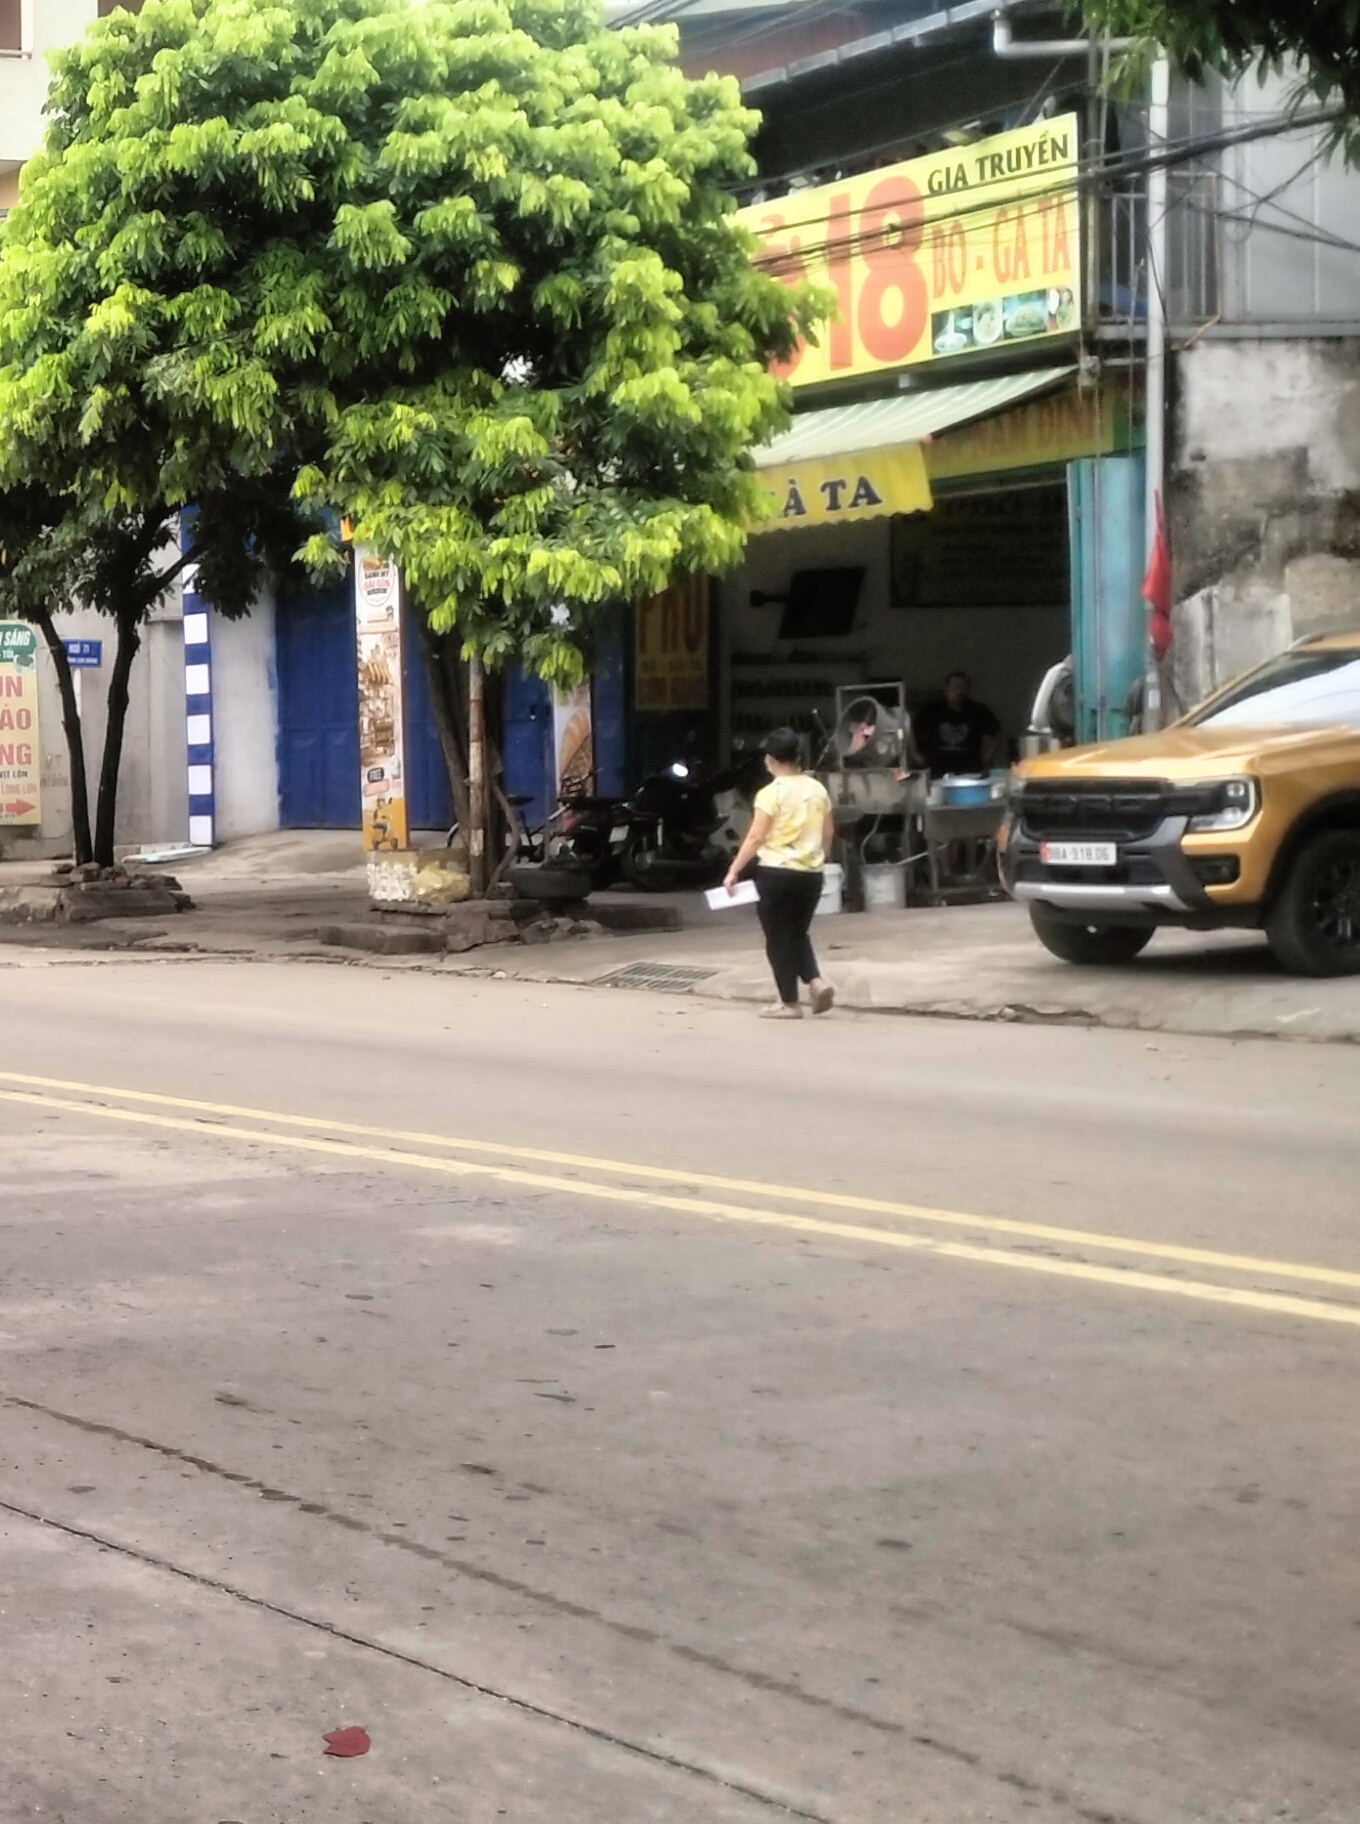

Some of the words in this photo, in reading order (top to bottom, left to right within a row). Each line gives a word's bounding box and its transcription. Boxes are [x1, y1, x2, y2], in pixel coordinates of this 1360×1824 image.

[927, 163, 968, 196] GIA
[975, 130, 1069, 182] TRUYỀN
[820, 475, 883, 511] TA
[4, 628, 31, 646] SÁNG
